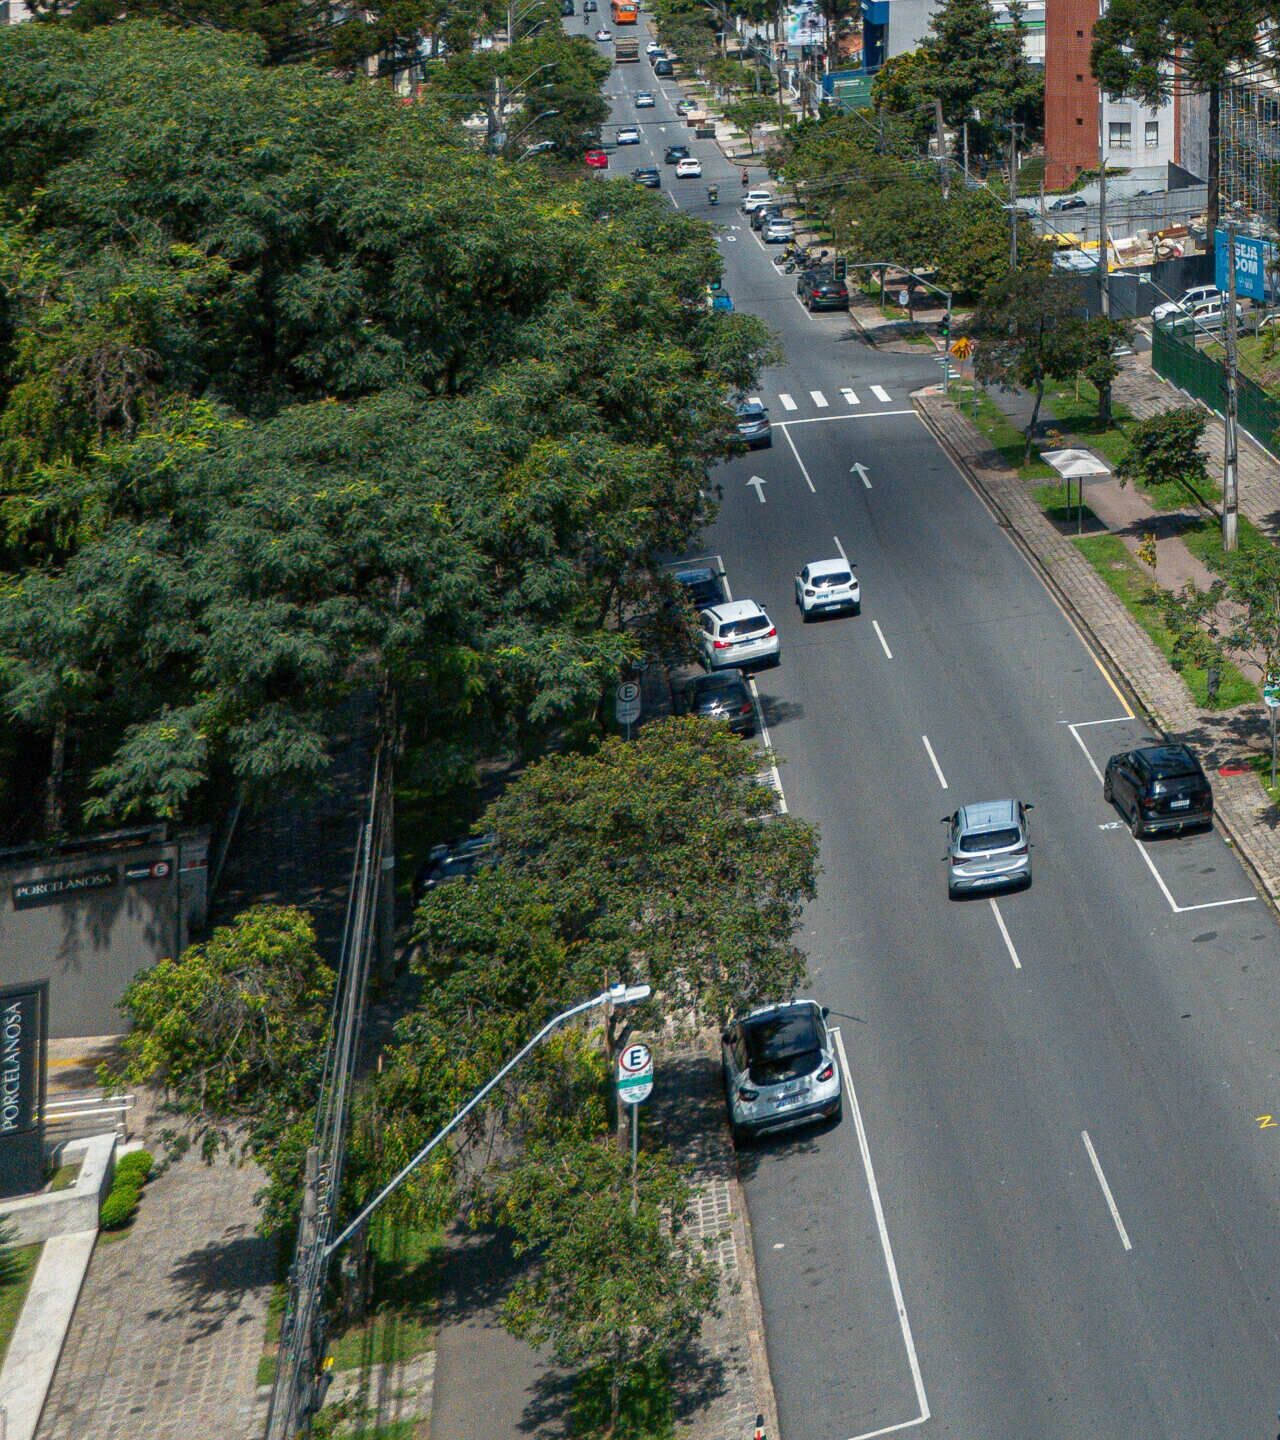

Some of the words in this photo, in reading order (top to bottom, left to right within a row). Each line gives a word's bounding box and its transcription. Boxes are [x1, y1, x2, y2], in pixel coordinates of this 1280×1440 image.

[15, 873, 112, 898] PORCELANOSA
[0, 1000, 22, 1133] PORCELANOSA
[630, 1048, 642, 1066] E
